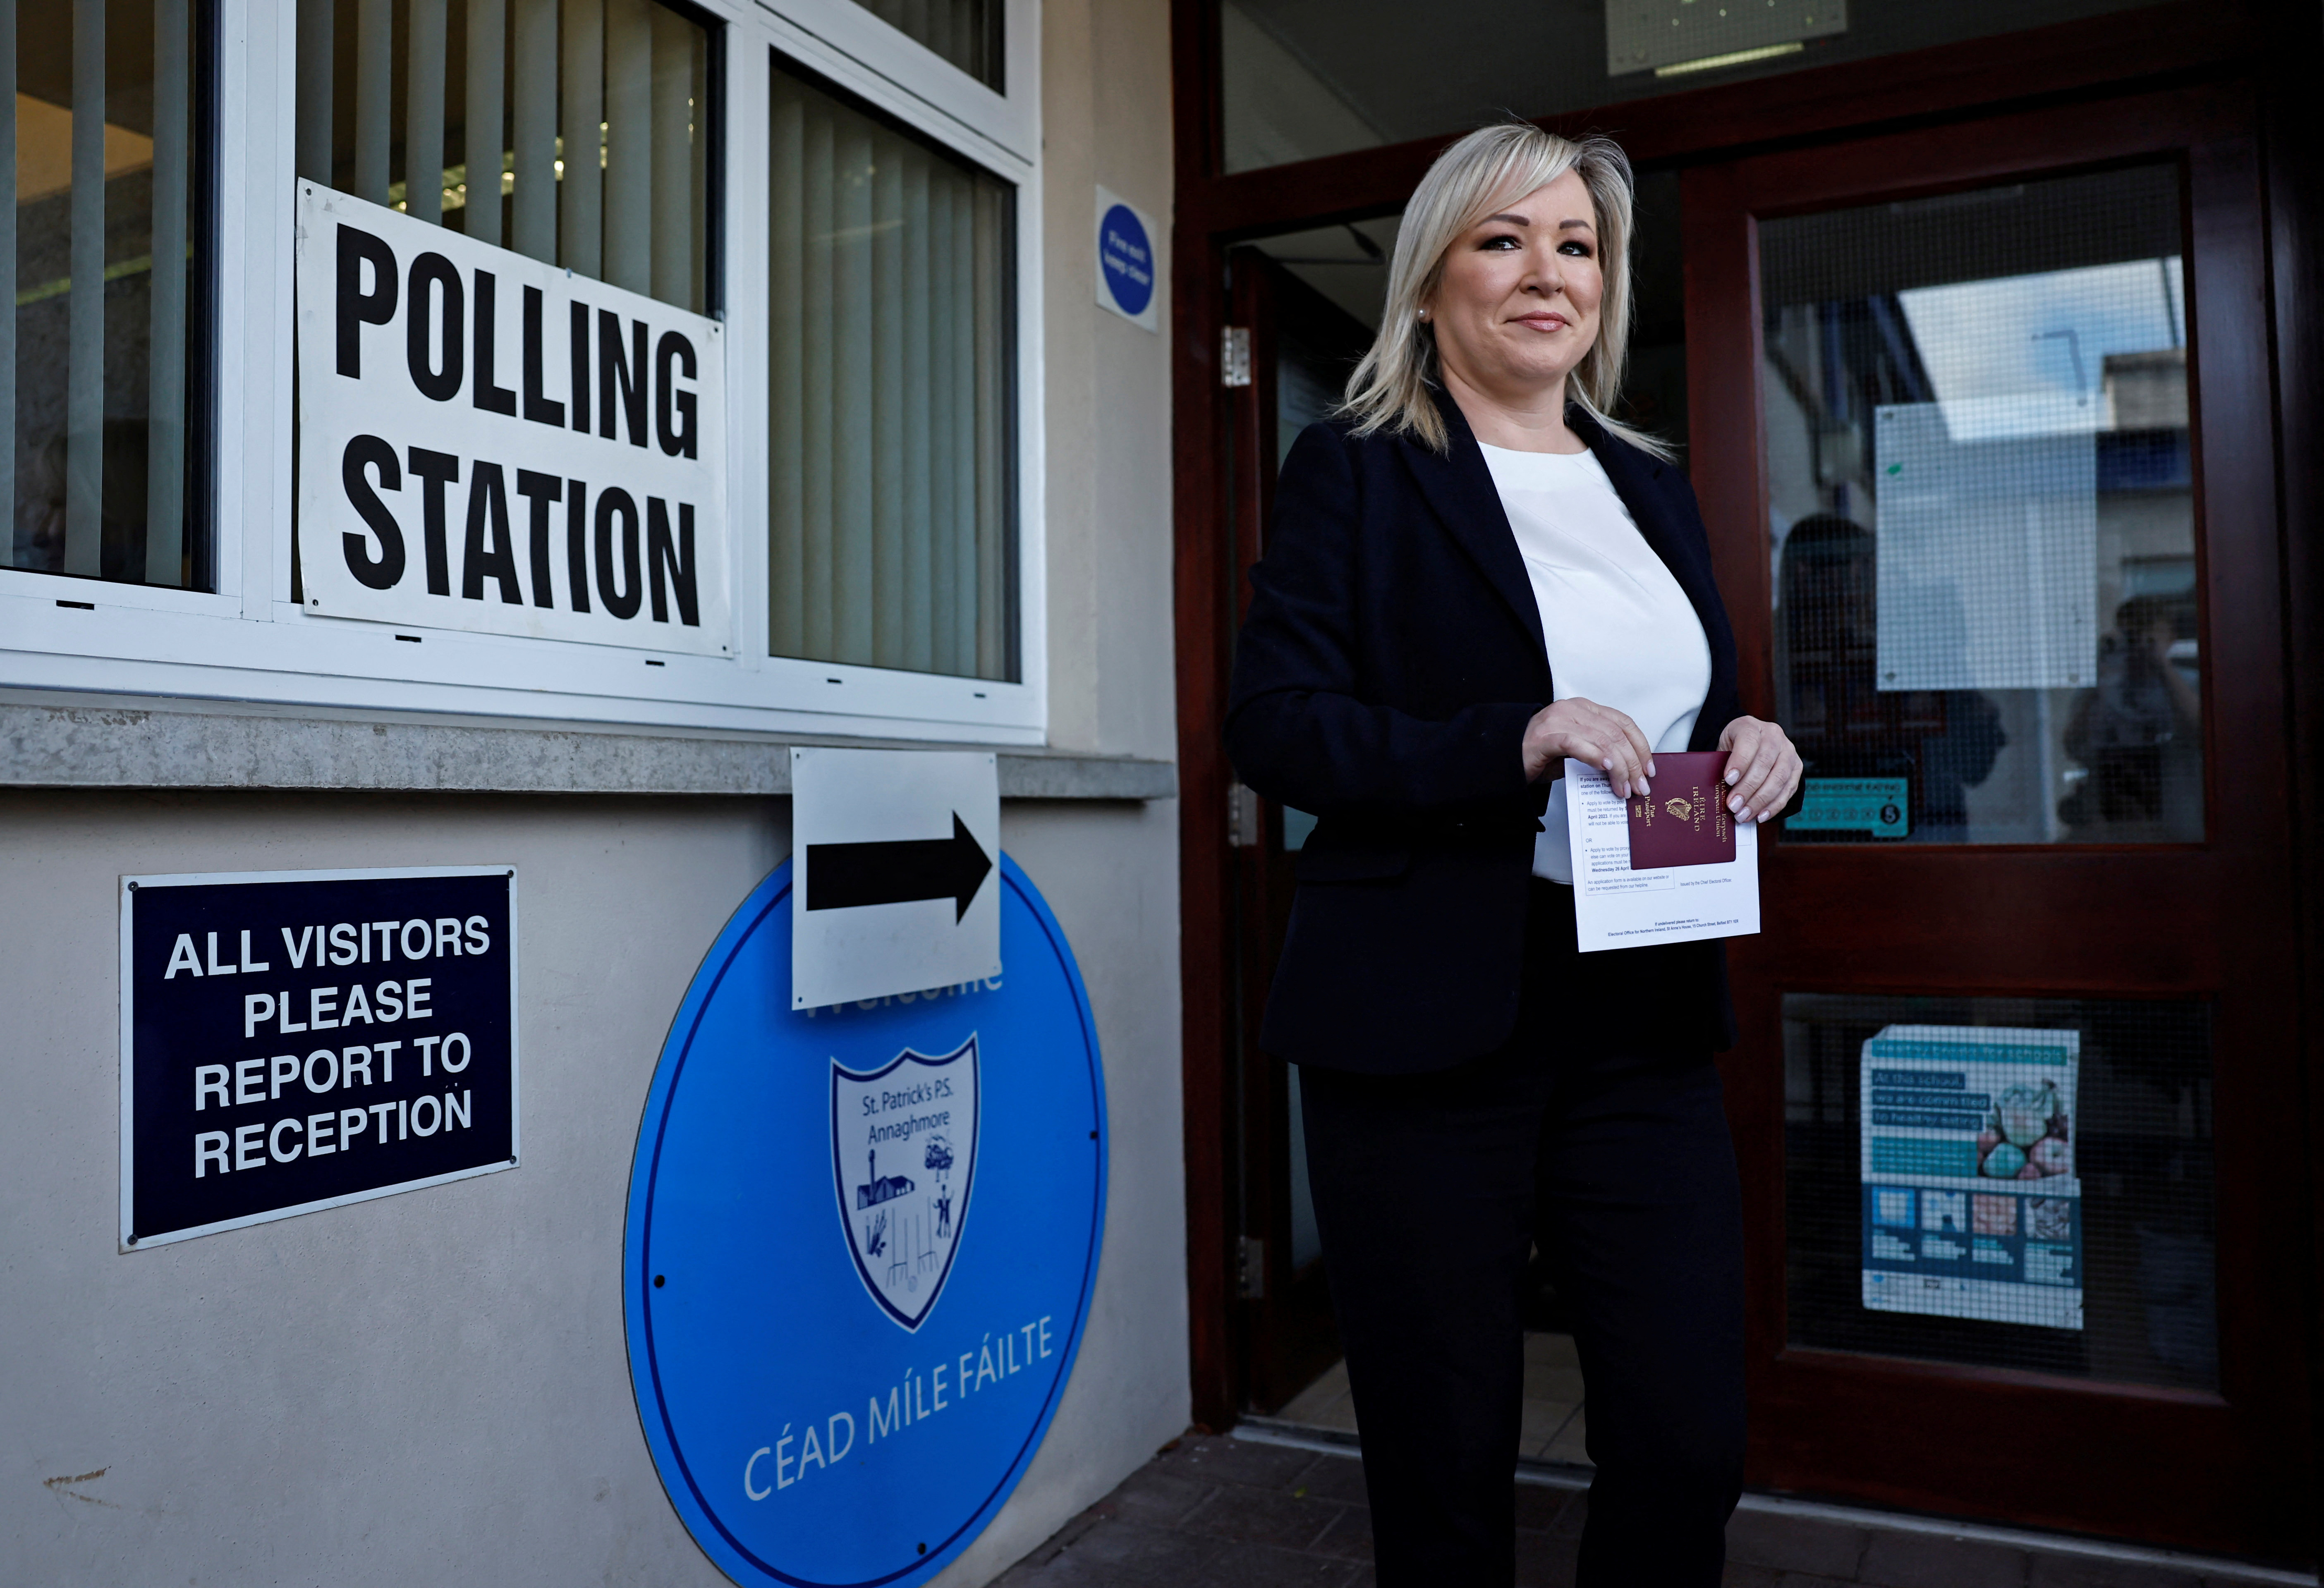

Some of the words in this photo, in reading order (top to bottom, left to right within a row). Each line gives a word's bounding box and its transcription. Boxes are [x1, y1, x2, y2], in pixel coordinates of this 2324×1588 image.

[336, 222, 698, 461] POLLING
[342, 433, 701, 628] STATION
[1884, 806, 1896, 822] 5
[164, 929, 270, 980] ALL
[281, 915, 491, 969] VISITORS
[245, 978, 433, 1038] PLEASE
[196, 1040, 402, 1112] REPORT
[414, 1032, 472, 1076] TO
[862, 1095, 880, 1117] St.
[882, 1081, 933, 1111] Patrick's
[934, 1077, 955, 1100] P.S.
[195, 1089, 472, 1179] RECEPTION
[867, 1110, 950, 1145] Annaghmore
[744, 1411, 856, 1502] CÉAD
[868, 1363, 949, 1444] MÍLE
[959, 1315, 1053, 1399] FÁILTE
